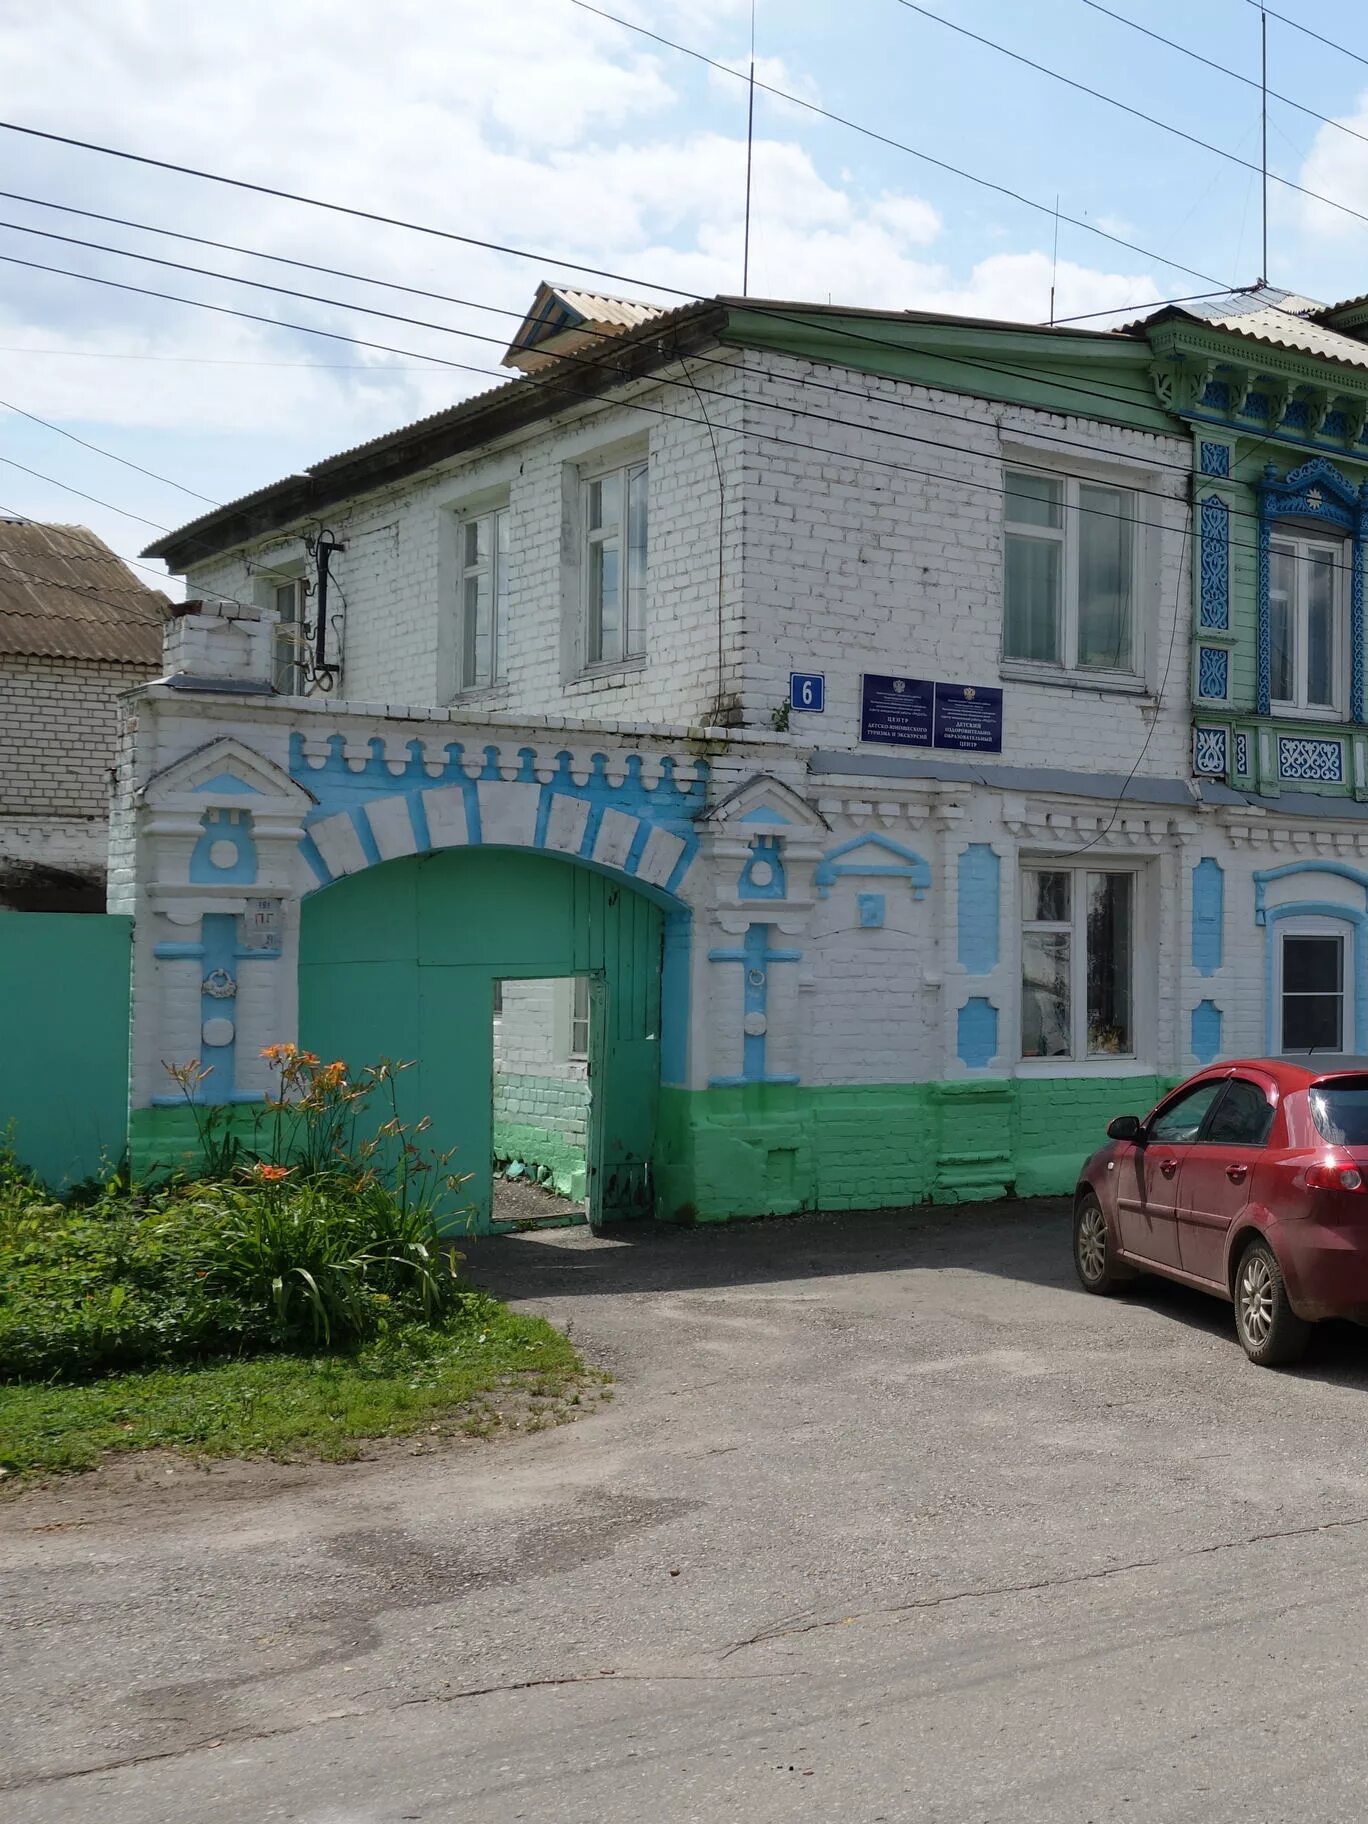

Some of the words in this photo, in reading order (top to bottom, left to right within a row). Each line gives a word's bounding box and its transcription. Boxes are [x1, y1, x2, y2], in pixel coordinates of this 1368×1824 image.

[802, 680, 812, 705] 6
[867, 729, 891, 737] ТУРИЗМА
[897, 732, 928, 740] ЭКСКУРСИЙ
